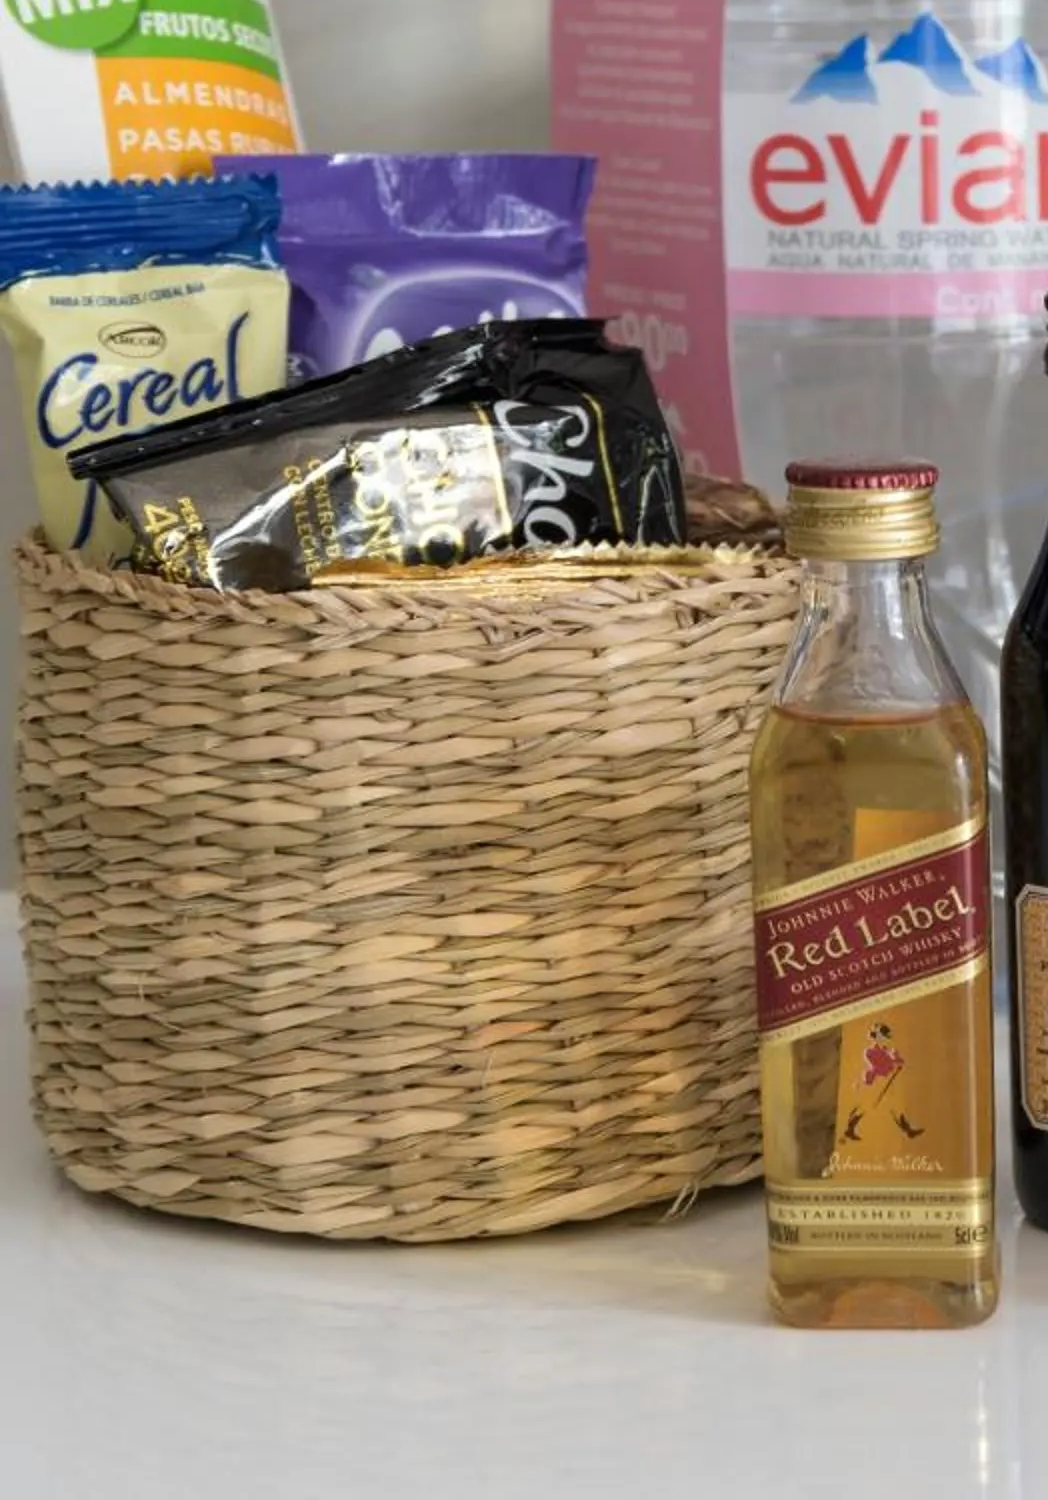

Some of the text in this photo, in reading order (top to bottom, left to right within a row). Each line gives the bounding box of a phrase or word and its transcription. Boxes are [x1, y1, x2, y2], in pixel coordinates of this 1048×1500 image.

[139, 10, 230, 43] FRUTOS
[119, 128, 223, 154] PASAS
[768, 229, 884, 249] NATURAL
[897, 229, 998, 248] SPRING
[838, 252, 933, 269] NATURAL
[947, 252, 976, 268] DE
[37, 308, 249, 449] Cereal
[767, 868, 937, 941] JOHNNIE WALKER
[766, 885, 971, 979] Red Label
[790, 972, 824, 994] OLD
[829, 951, 894, 980] SCOTCH
[900, 926, 962, 958] WHISKY
[777, 1207, 911, 1220] ESTABLISHED
